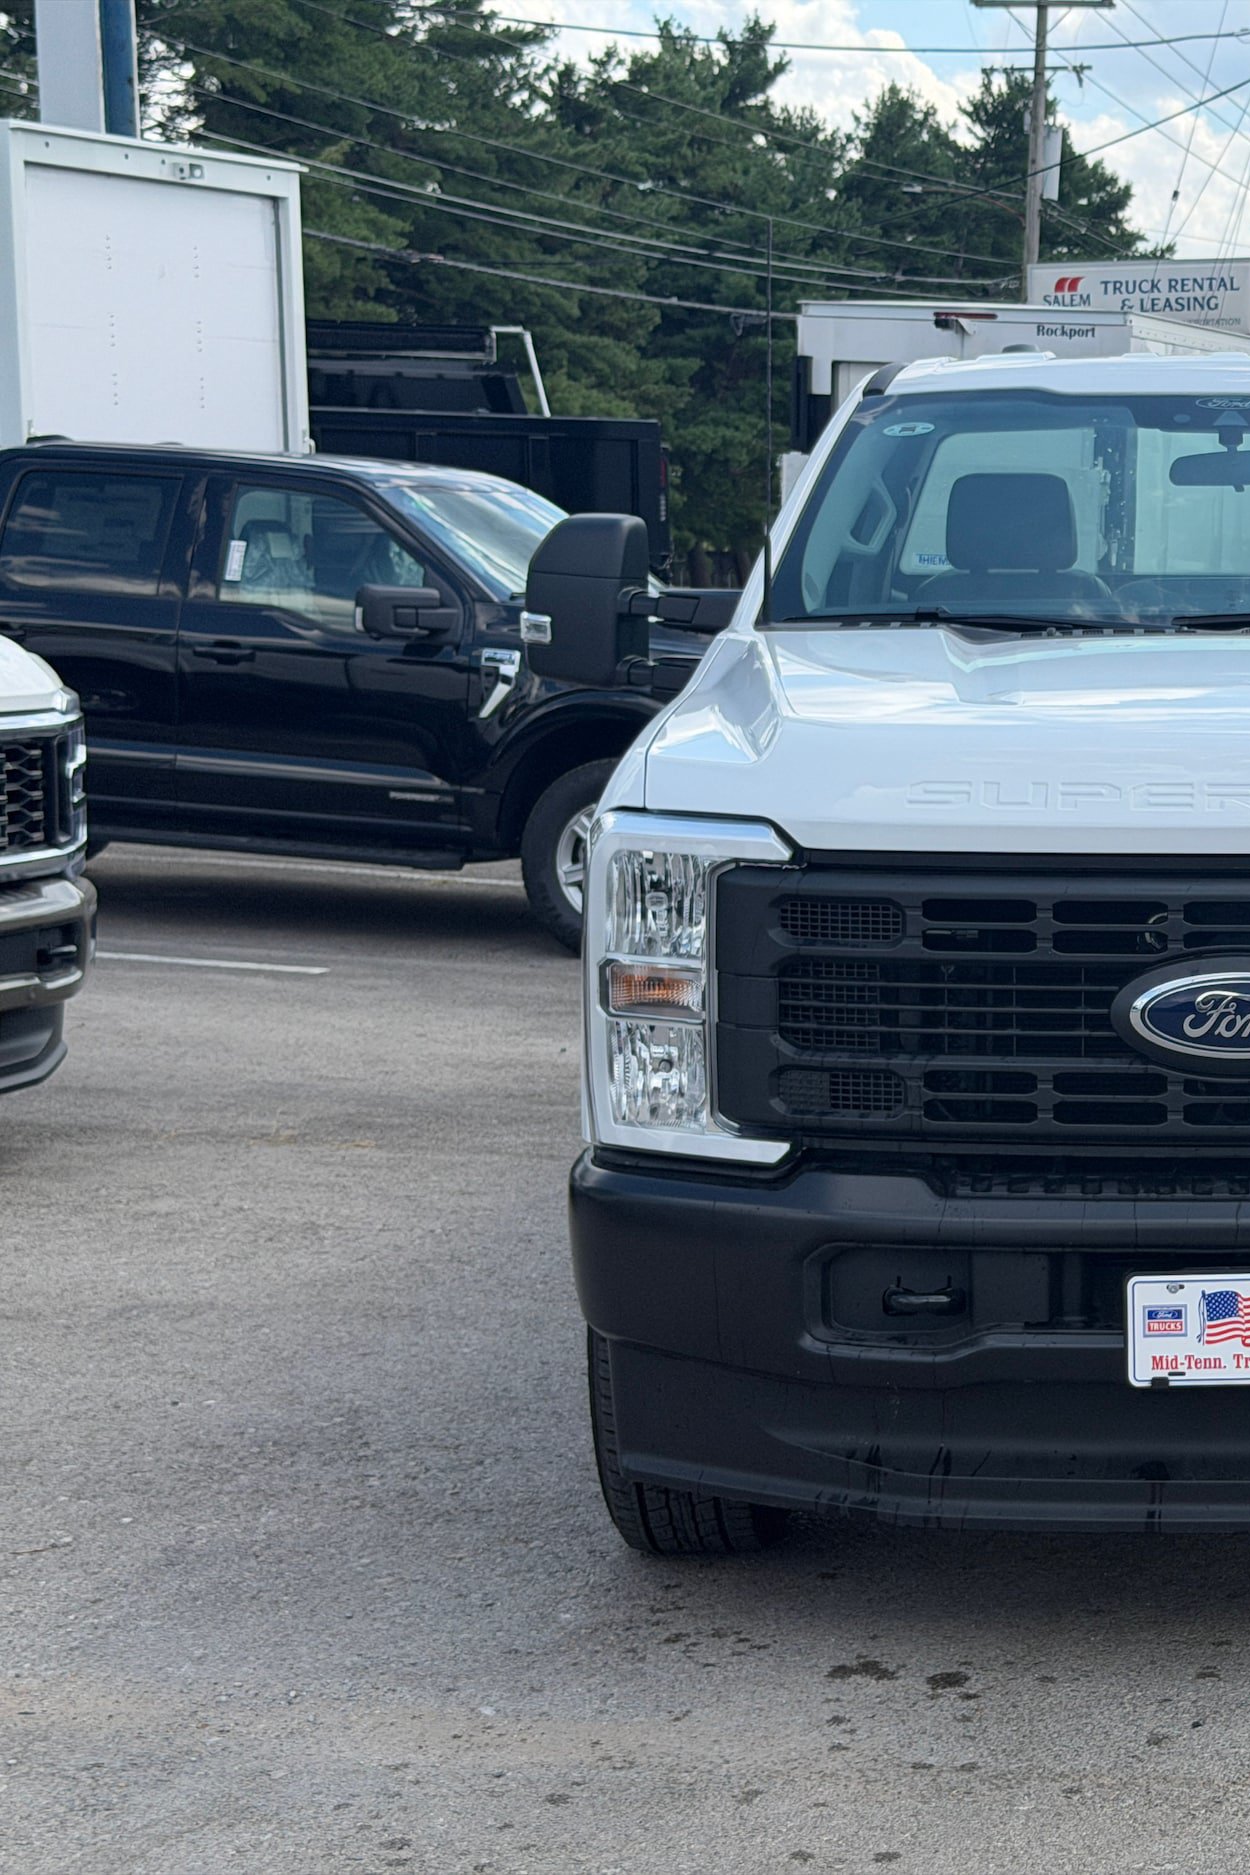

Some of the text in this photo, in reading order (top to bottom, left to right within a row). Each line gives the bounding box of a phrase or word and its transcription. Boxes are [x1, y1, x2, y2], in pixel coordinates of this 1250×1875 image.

[1100, 276, 1240, 296] TRUCK RENTAL
[1043, 294, 1091, 307] SALEM
[1120, 296, 1219, 313] & LEASING
[1036, 324, 1096, 340] Rockport
[1150, 1322, 1182, 1331] TRUCKS
[1151, 1355, 1227, 1370] Mid-Tenn.
